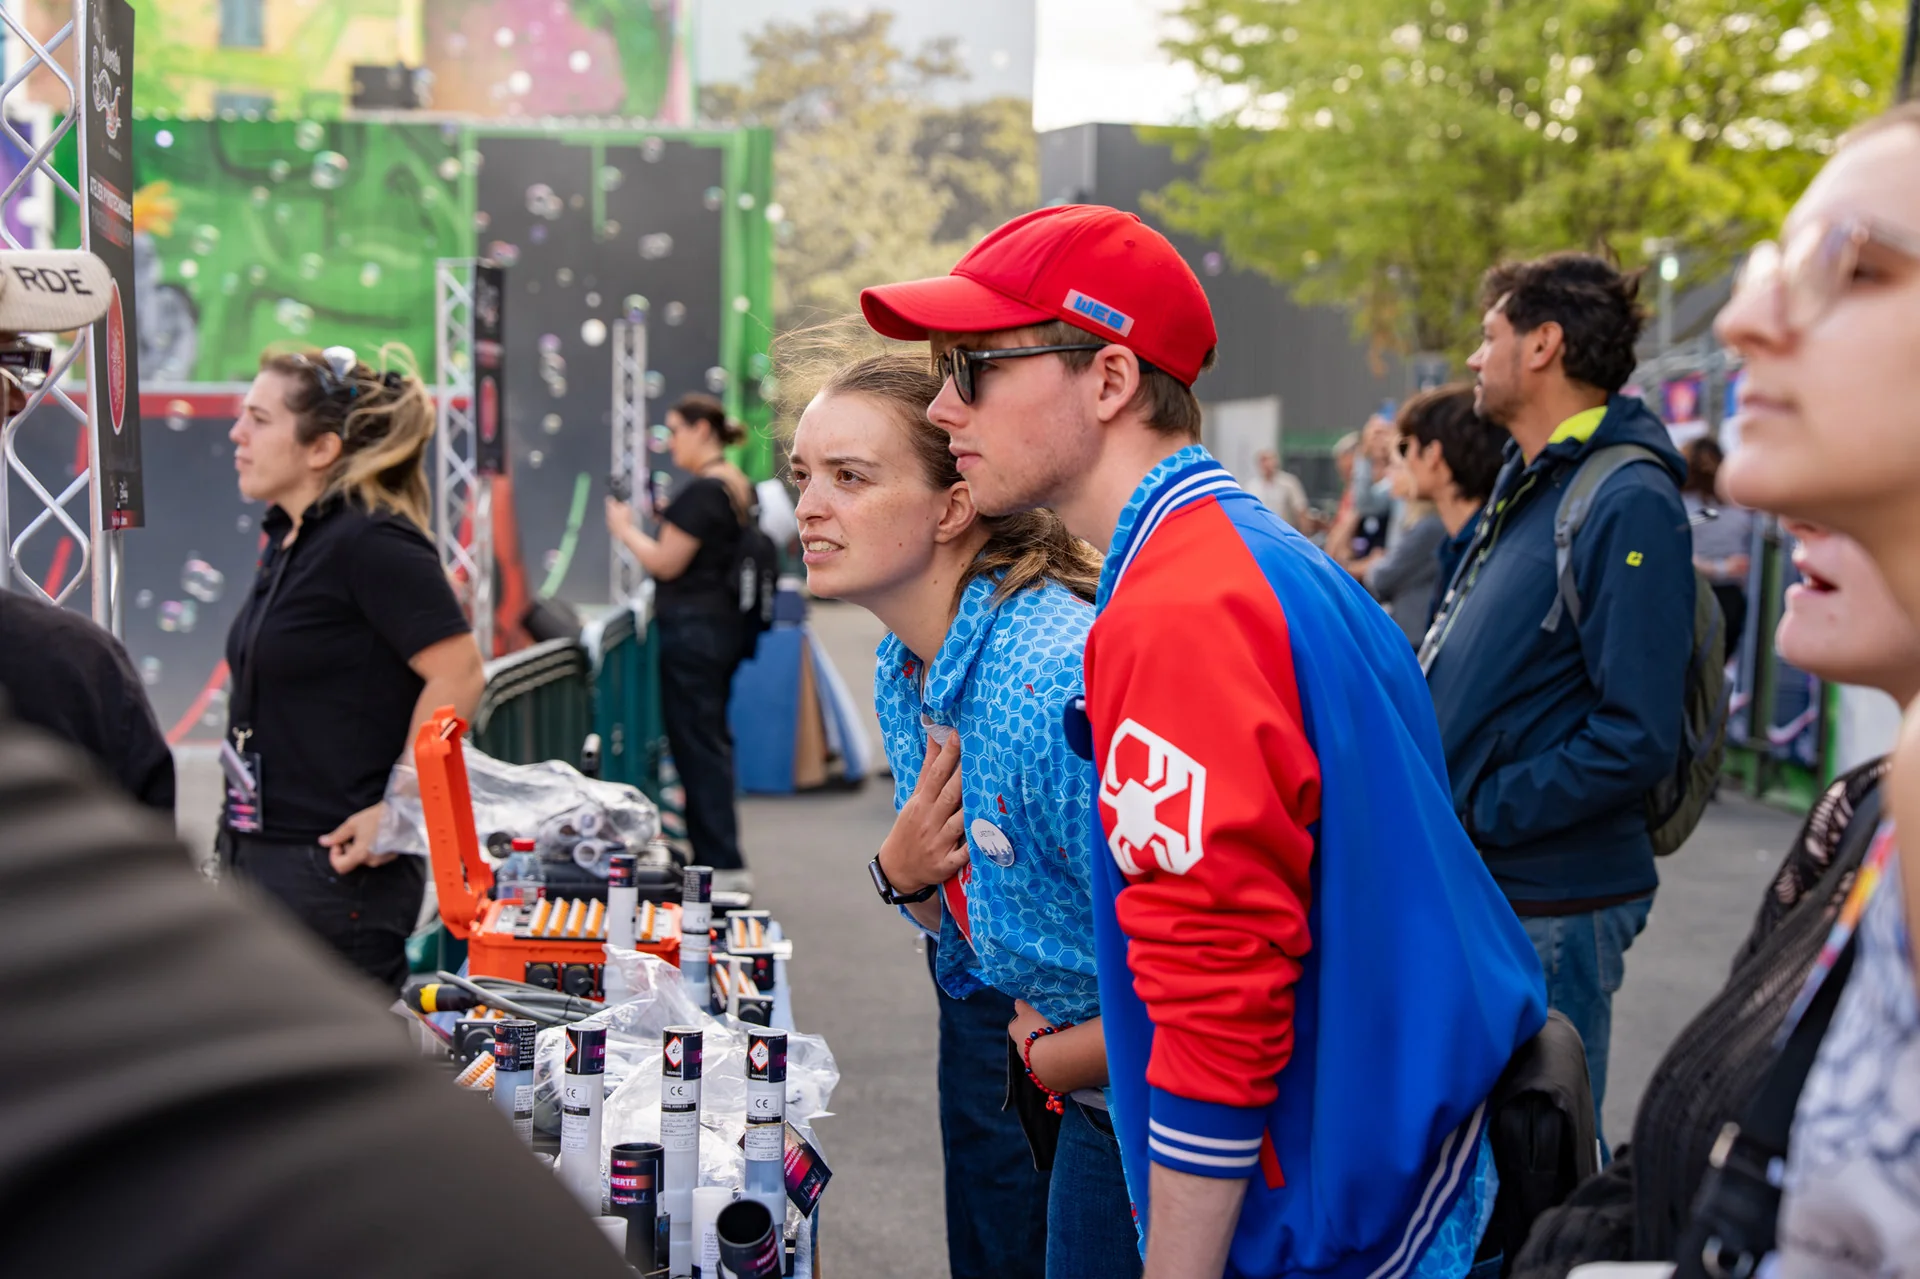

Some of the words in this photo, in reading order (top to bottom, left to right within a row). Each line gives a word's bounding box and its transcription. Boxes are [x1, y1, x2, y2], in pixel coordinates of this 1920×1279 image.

[12, 266, 93, 295] RDE
[1073, 295, 1125, 329] WEB
[566, 1087, 576, 1098] CE
[670, 1086, 683, 1096] CE
[755, 1099, 768, 1109] CE
